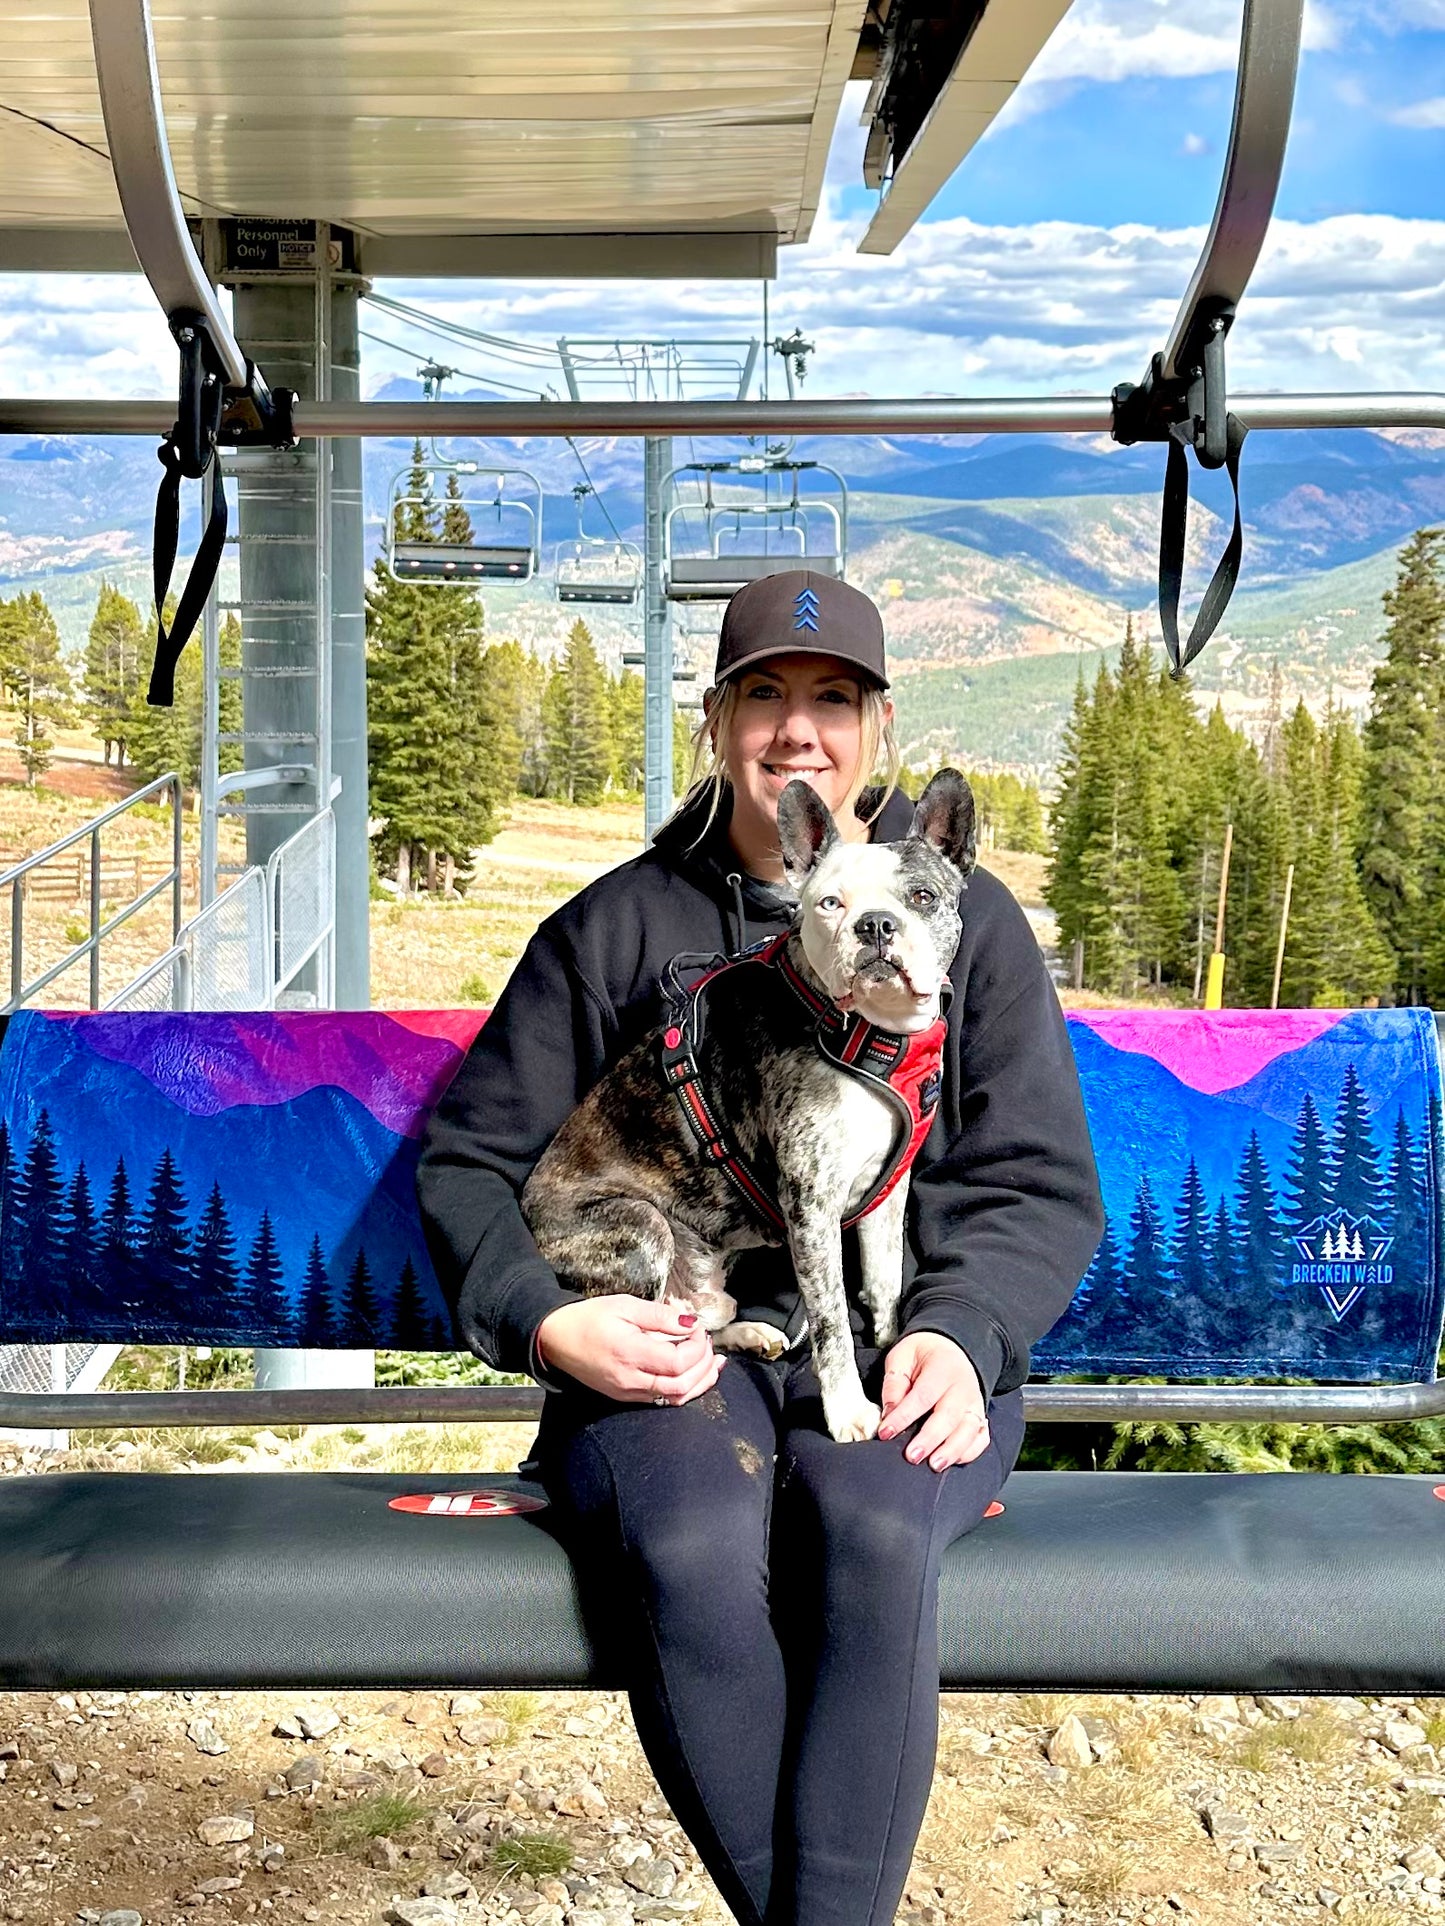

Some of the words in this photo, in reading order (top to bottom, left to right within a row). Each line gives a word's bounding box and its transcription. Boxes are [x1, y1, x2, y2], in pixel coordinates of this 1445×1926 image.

[237, 228, 299, 241] Personnel
[237, 244, 267, 260] Only
[281, 244, 313, 252] NOTICE
[1292, 1264, 1351, 1284] BRECKEN
